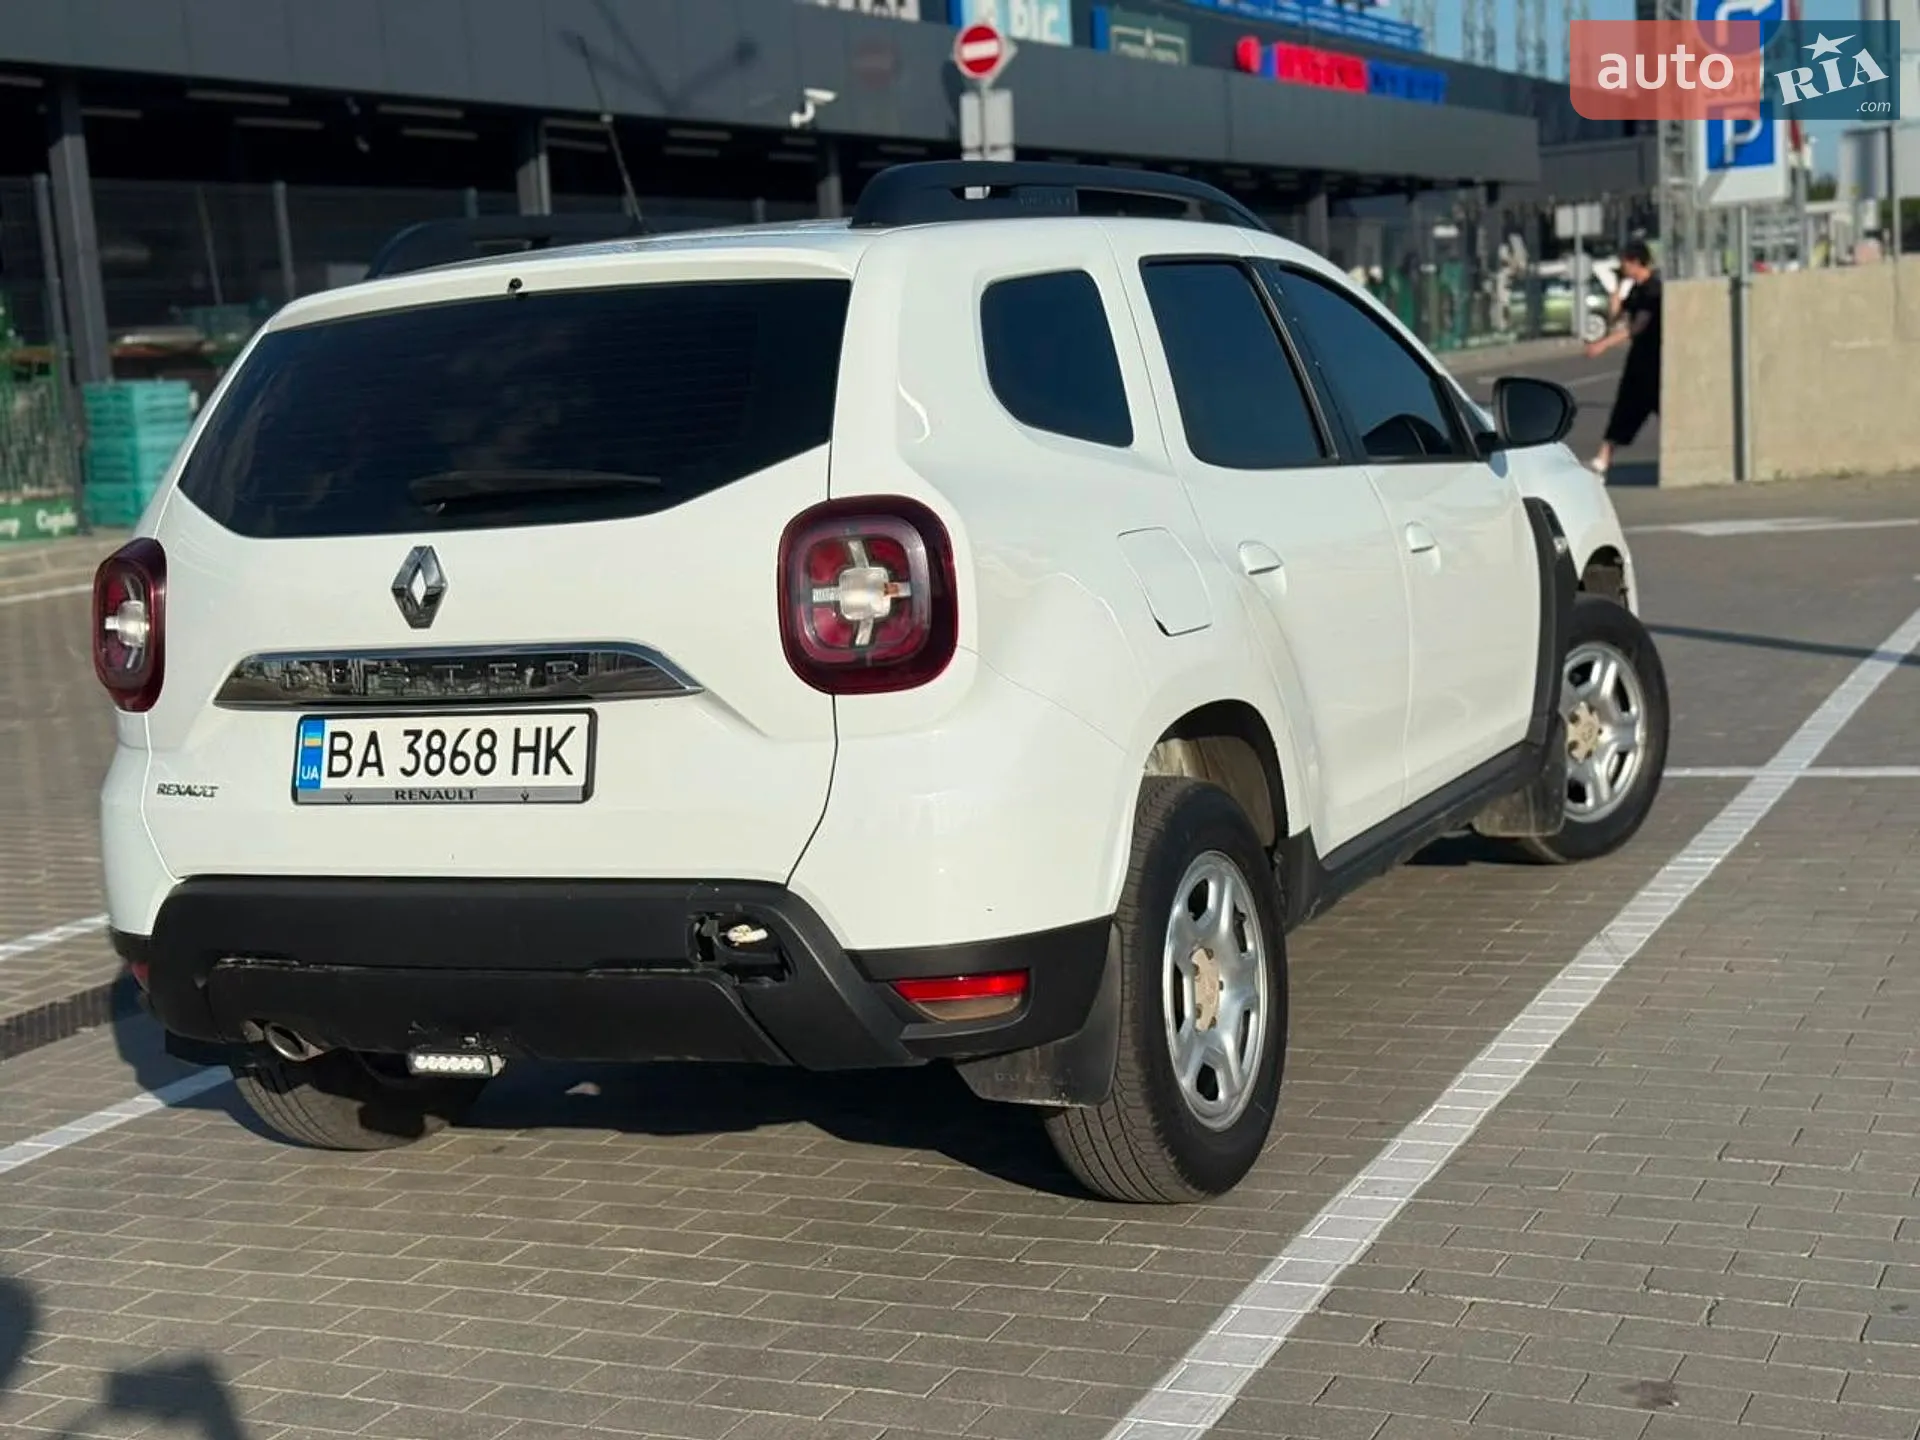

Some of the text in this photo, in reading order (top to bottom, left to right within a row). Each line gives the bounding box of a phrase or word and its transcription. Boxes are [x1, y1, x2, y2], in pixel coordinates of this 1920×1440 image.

[1723, 106, 1763, 164] P
[327, 726, 577, 778] BA 3868 HK
[301, 766, 320, 780] UA
[156, 783, 219, 798] RENAULT
[394, 788, 479, 801] RENAULT
